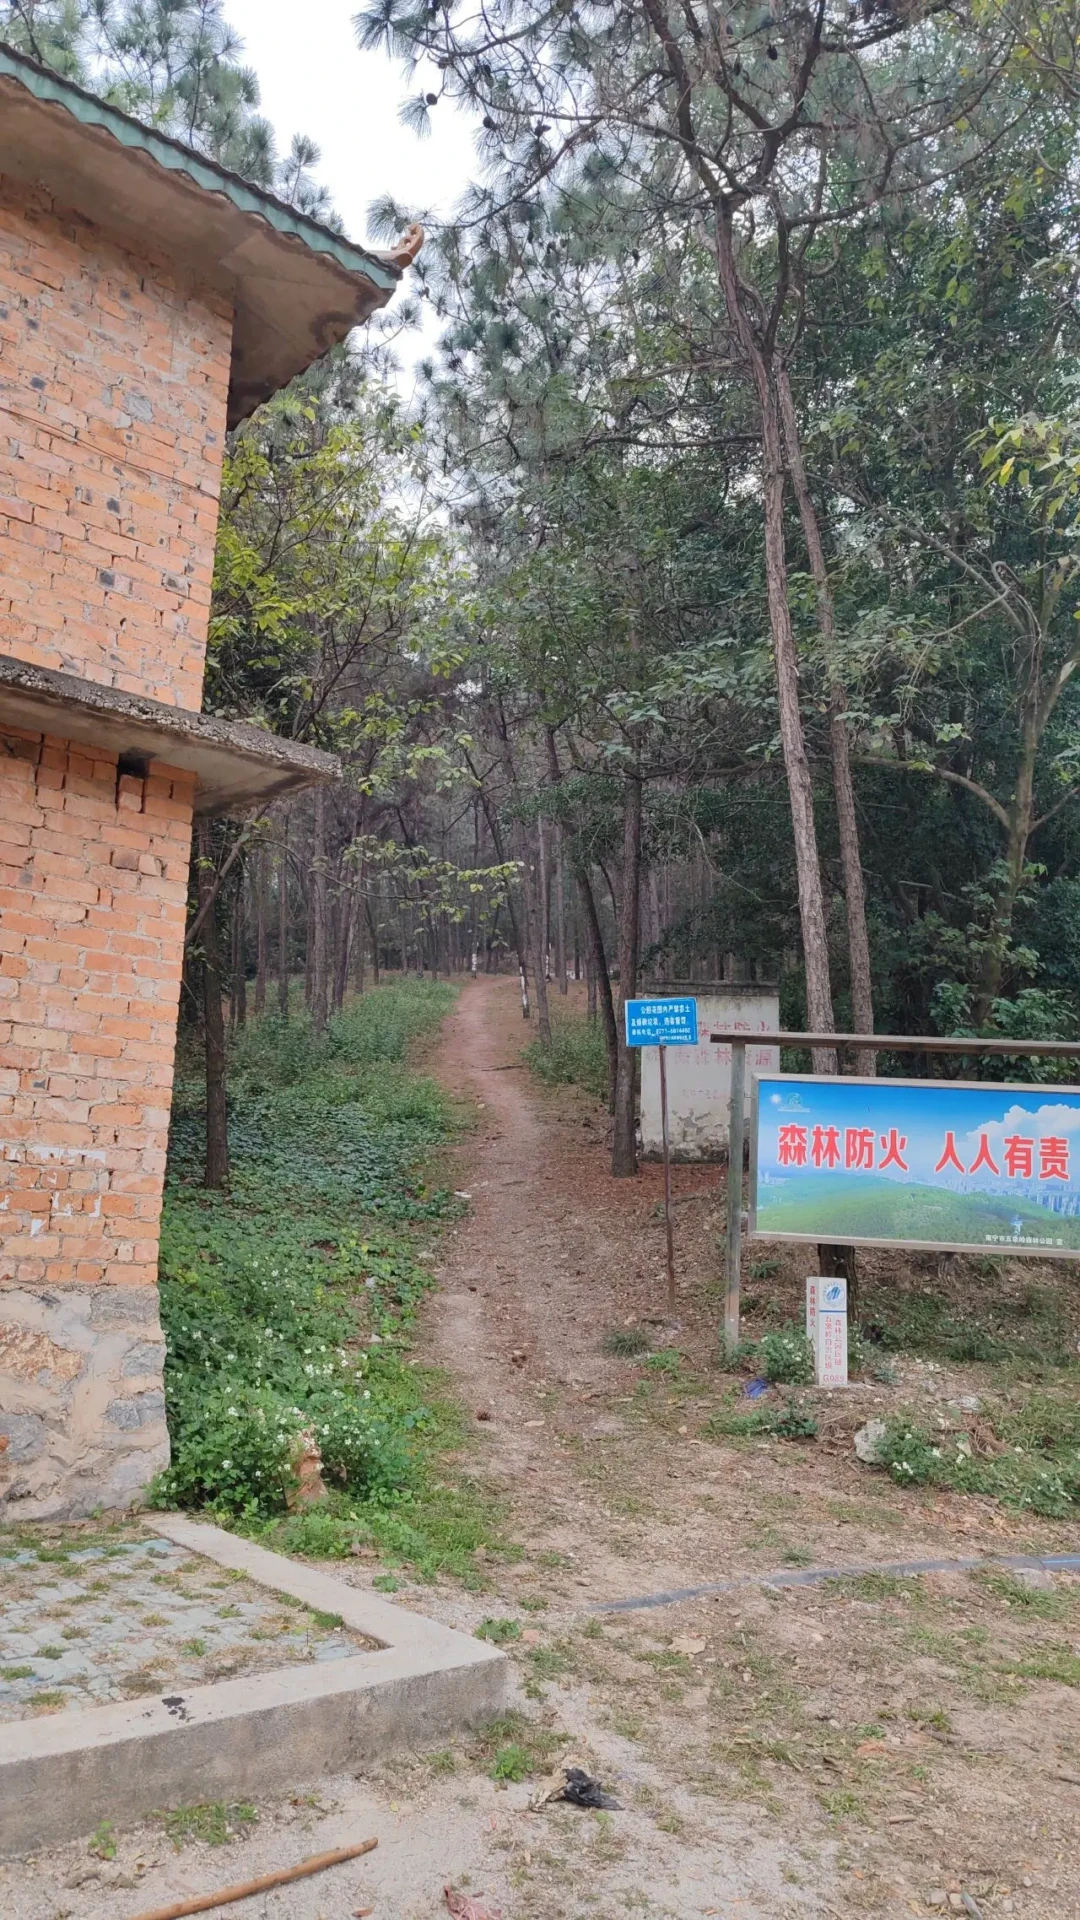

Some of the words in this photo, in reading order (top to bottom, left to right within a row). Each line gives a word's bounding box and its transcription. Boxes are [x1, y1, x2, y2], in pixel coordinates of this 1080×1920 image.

[777, 1123, 908, 1172] 森林防火
[934, 1131, 1070, 1181] 人人有责
